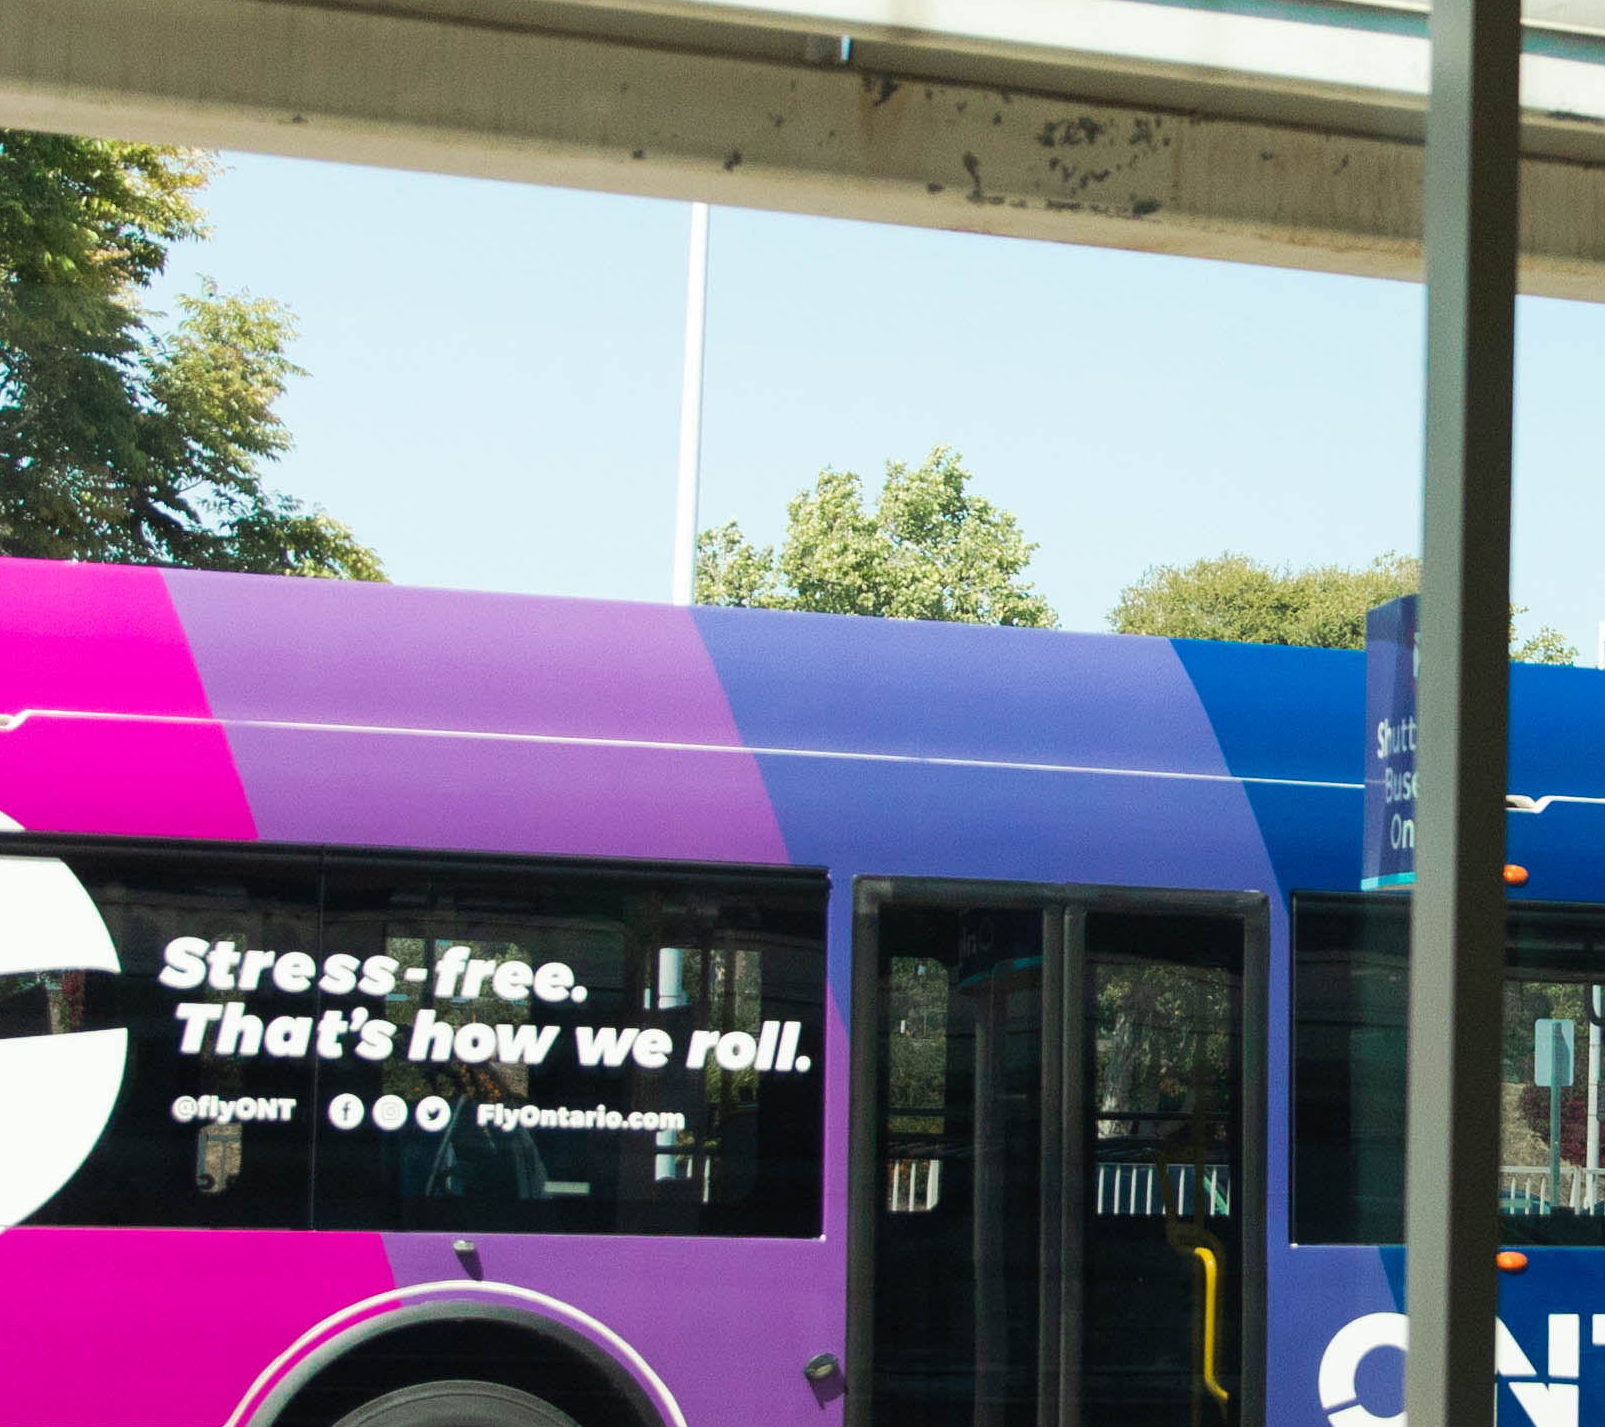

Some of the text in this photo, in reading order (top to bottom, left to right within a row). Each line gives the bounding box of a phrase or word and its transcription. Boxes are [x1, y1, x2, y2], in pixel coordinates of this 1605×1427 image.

[1377, 716, 1417, 760] Shutt
[1390, 813, 1415, 851] On
[158, 936, 589, 1004] Stress-free.
[175, 1002, 812, 1074] That's how we roll.
[172, 1095, 685, 1134] @flyONT FlyOntario.com
